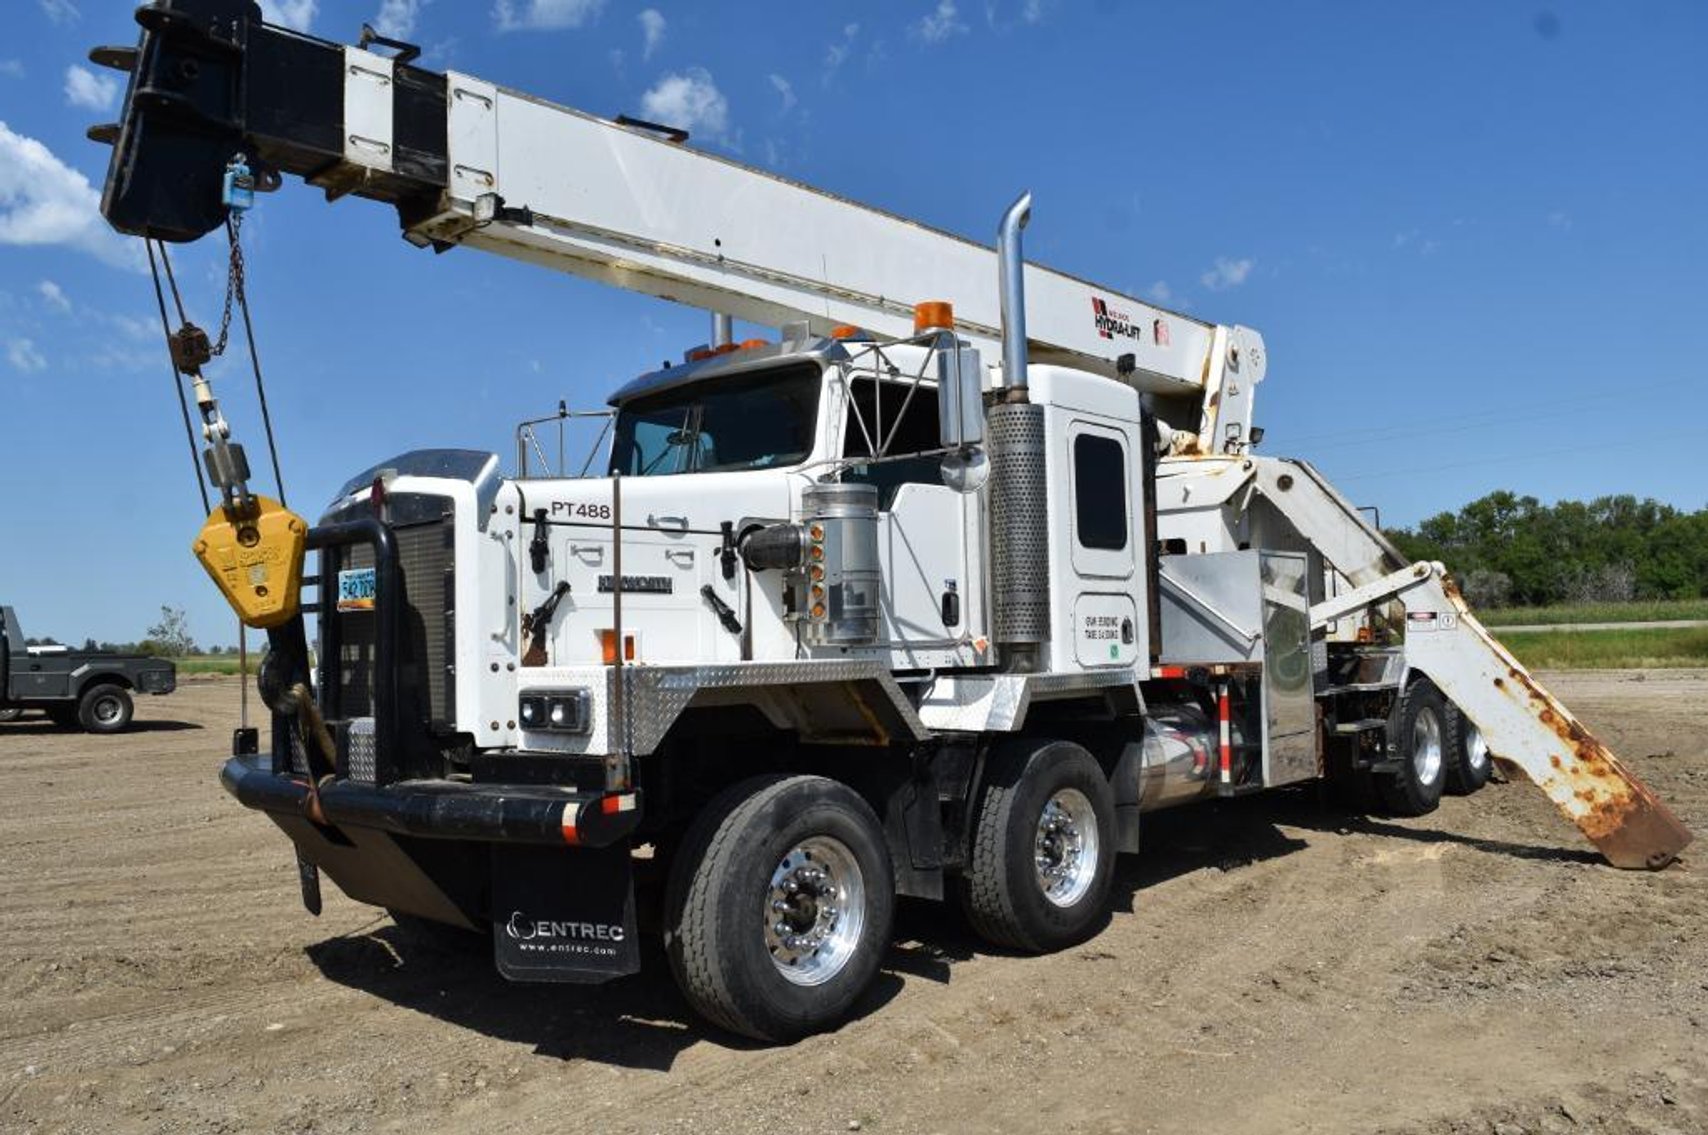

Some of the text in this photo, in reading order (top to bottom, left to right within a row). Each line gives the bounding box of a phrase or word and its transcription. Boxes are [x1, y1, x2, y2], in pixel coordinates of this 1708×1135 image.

[551, 501, 610, 519] PT488
[598, 575, 672, 591] KEWORTH
[536, 921, 625, 941] ENTREC
[519, 943, 617, 956] www.entrec.com
